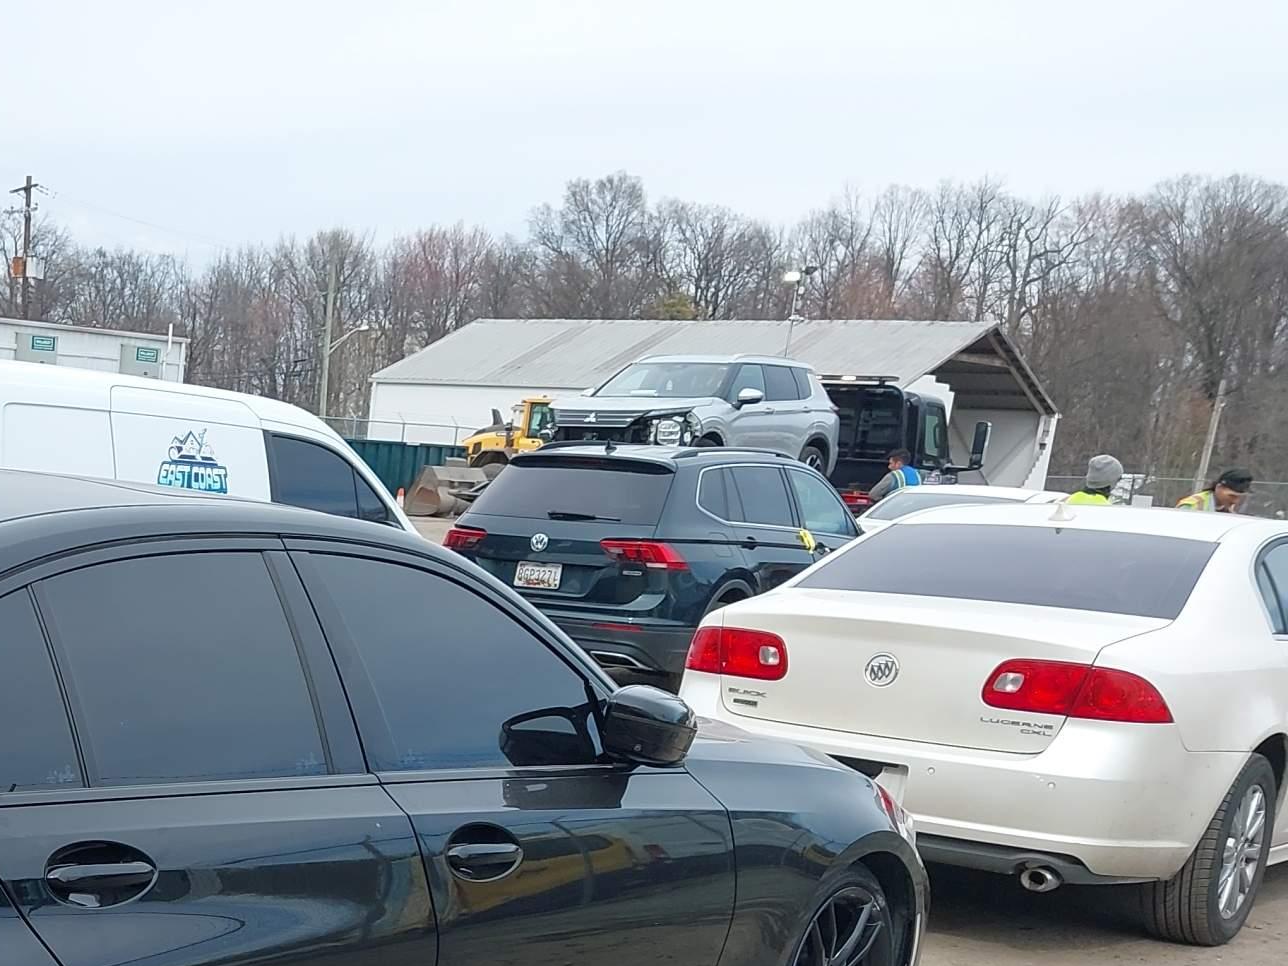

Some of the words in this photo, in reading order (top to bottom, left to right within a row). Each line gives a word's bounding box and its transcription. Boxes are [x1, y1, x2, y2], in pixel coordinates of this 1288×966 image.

[159, 463, 191, 488] EAST
[191, 466, 227, 492] COAST
[728, 687, 768, 699] BUICK
[979, 717, 1054, 730] LUCERNE
[1020, 728, 1053, 737] CXL
